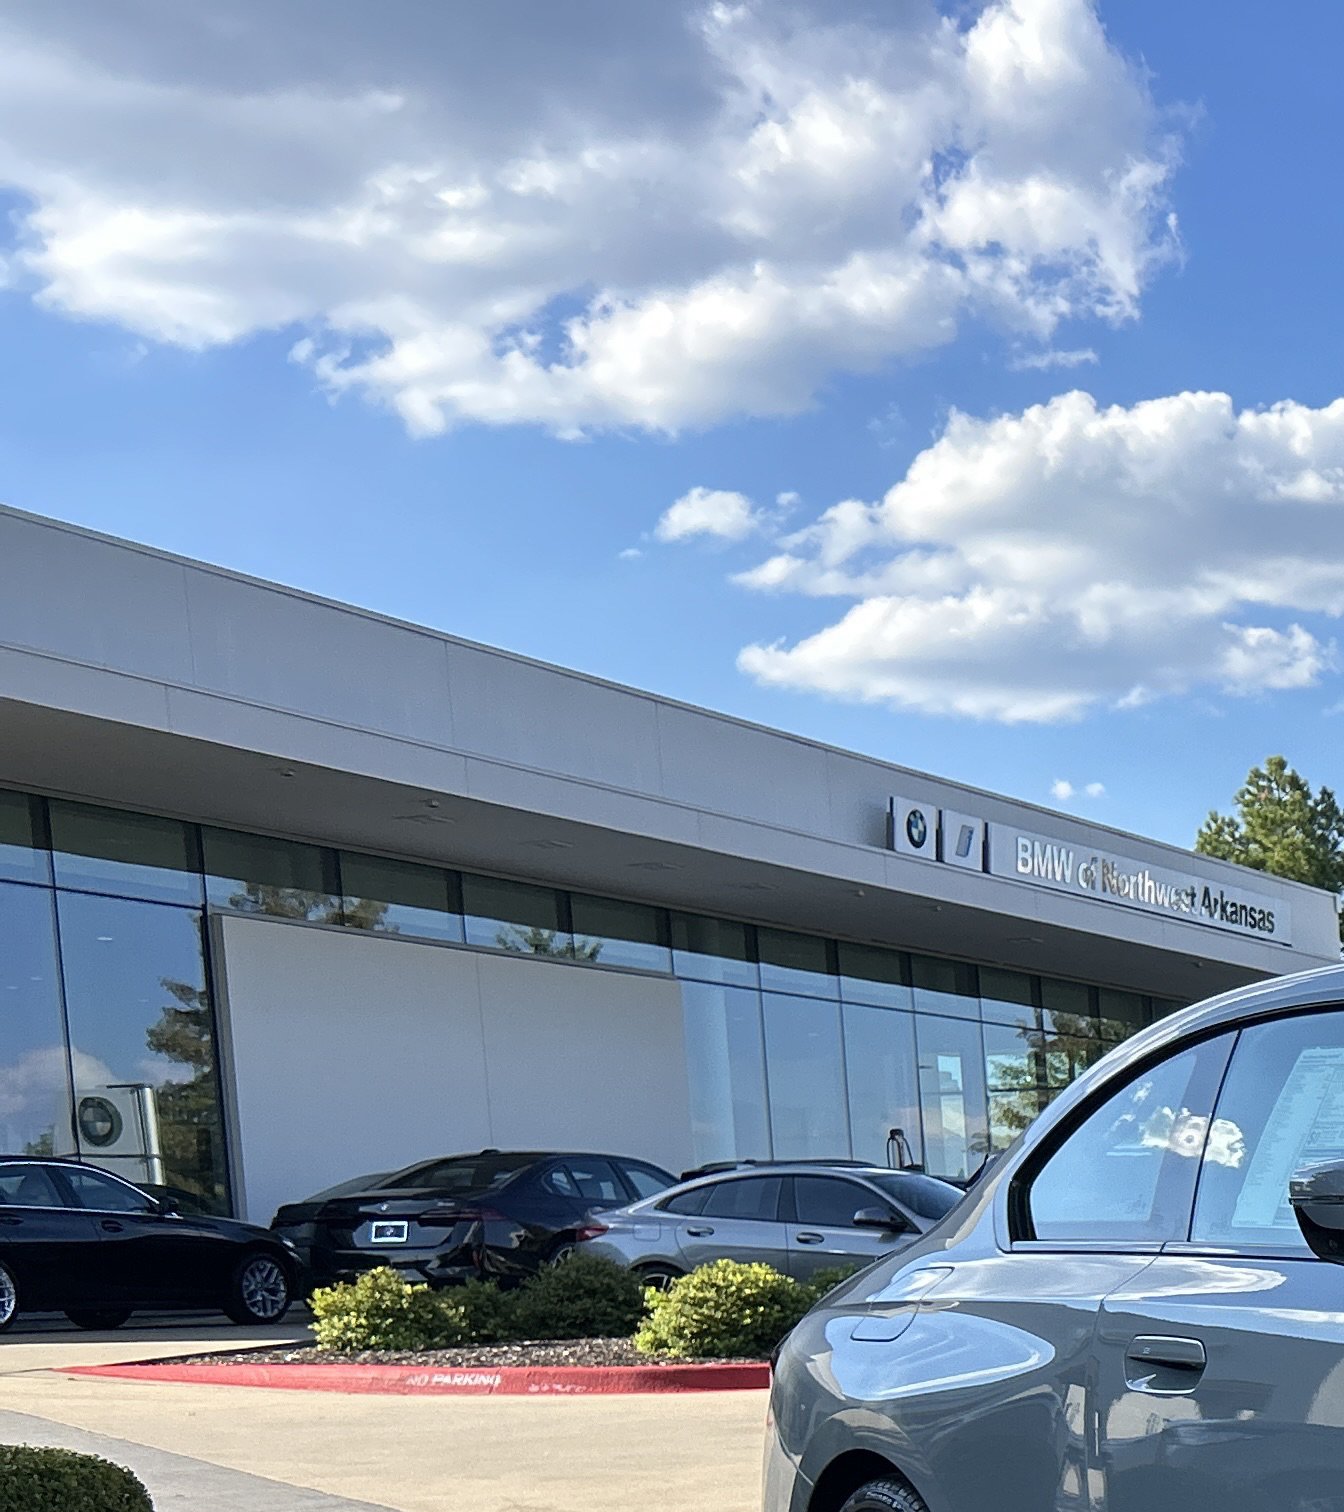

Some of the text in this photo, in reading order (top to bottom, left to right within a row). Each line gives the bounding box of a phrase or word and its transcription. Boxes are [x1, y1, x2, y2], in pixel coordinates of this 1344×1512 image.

[1017, 836, 1275, 933] BMW of Northwest Arkansas
